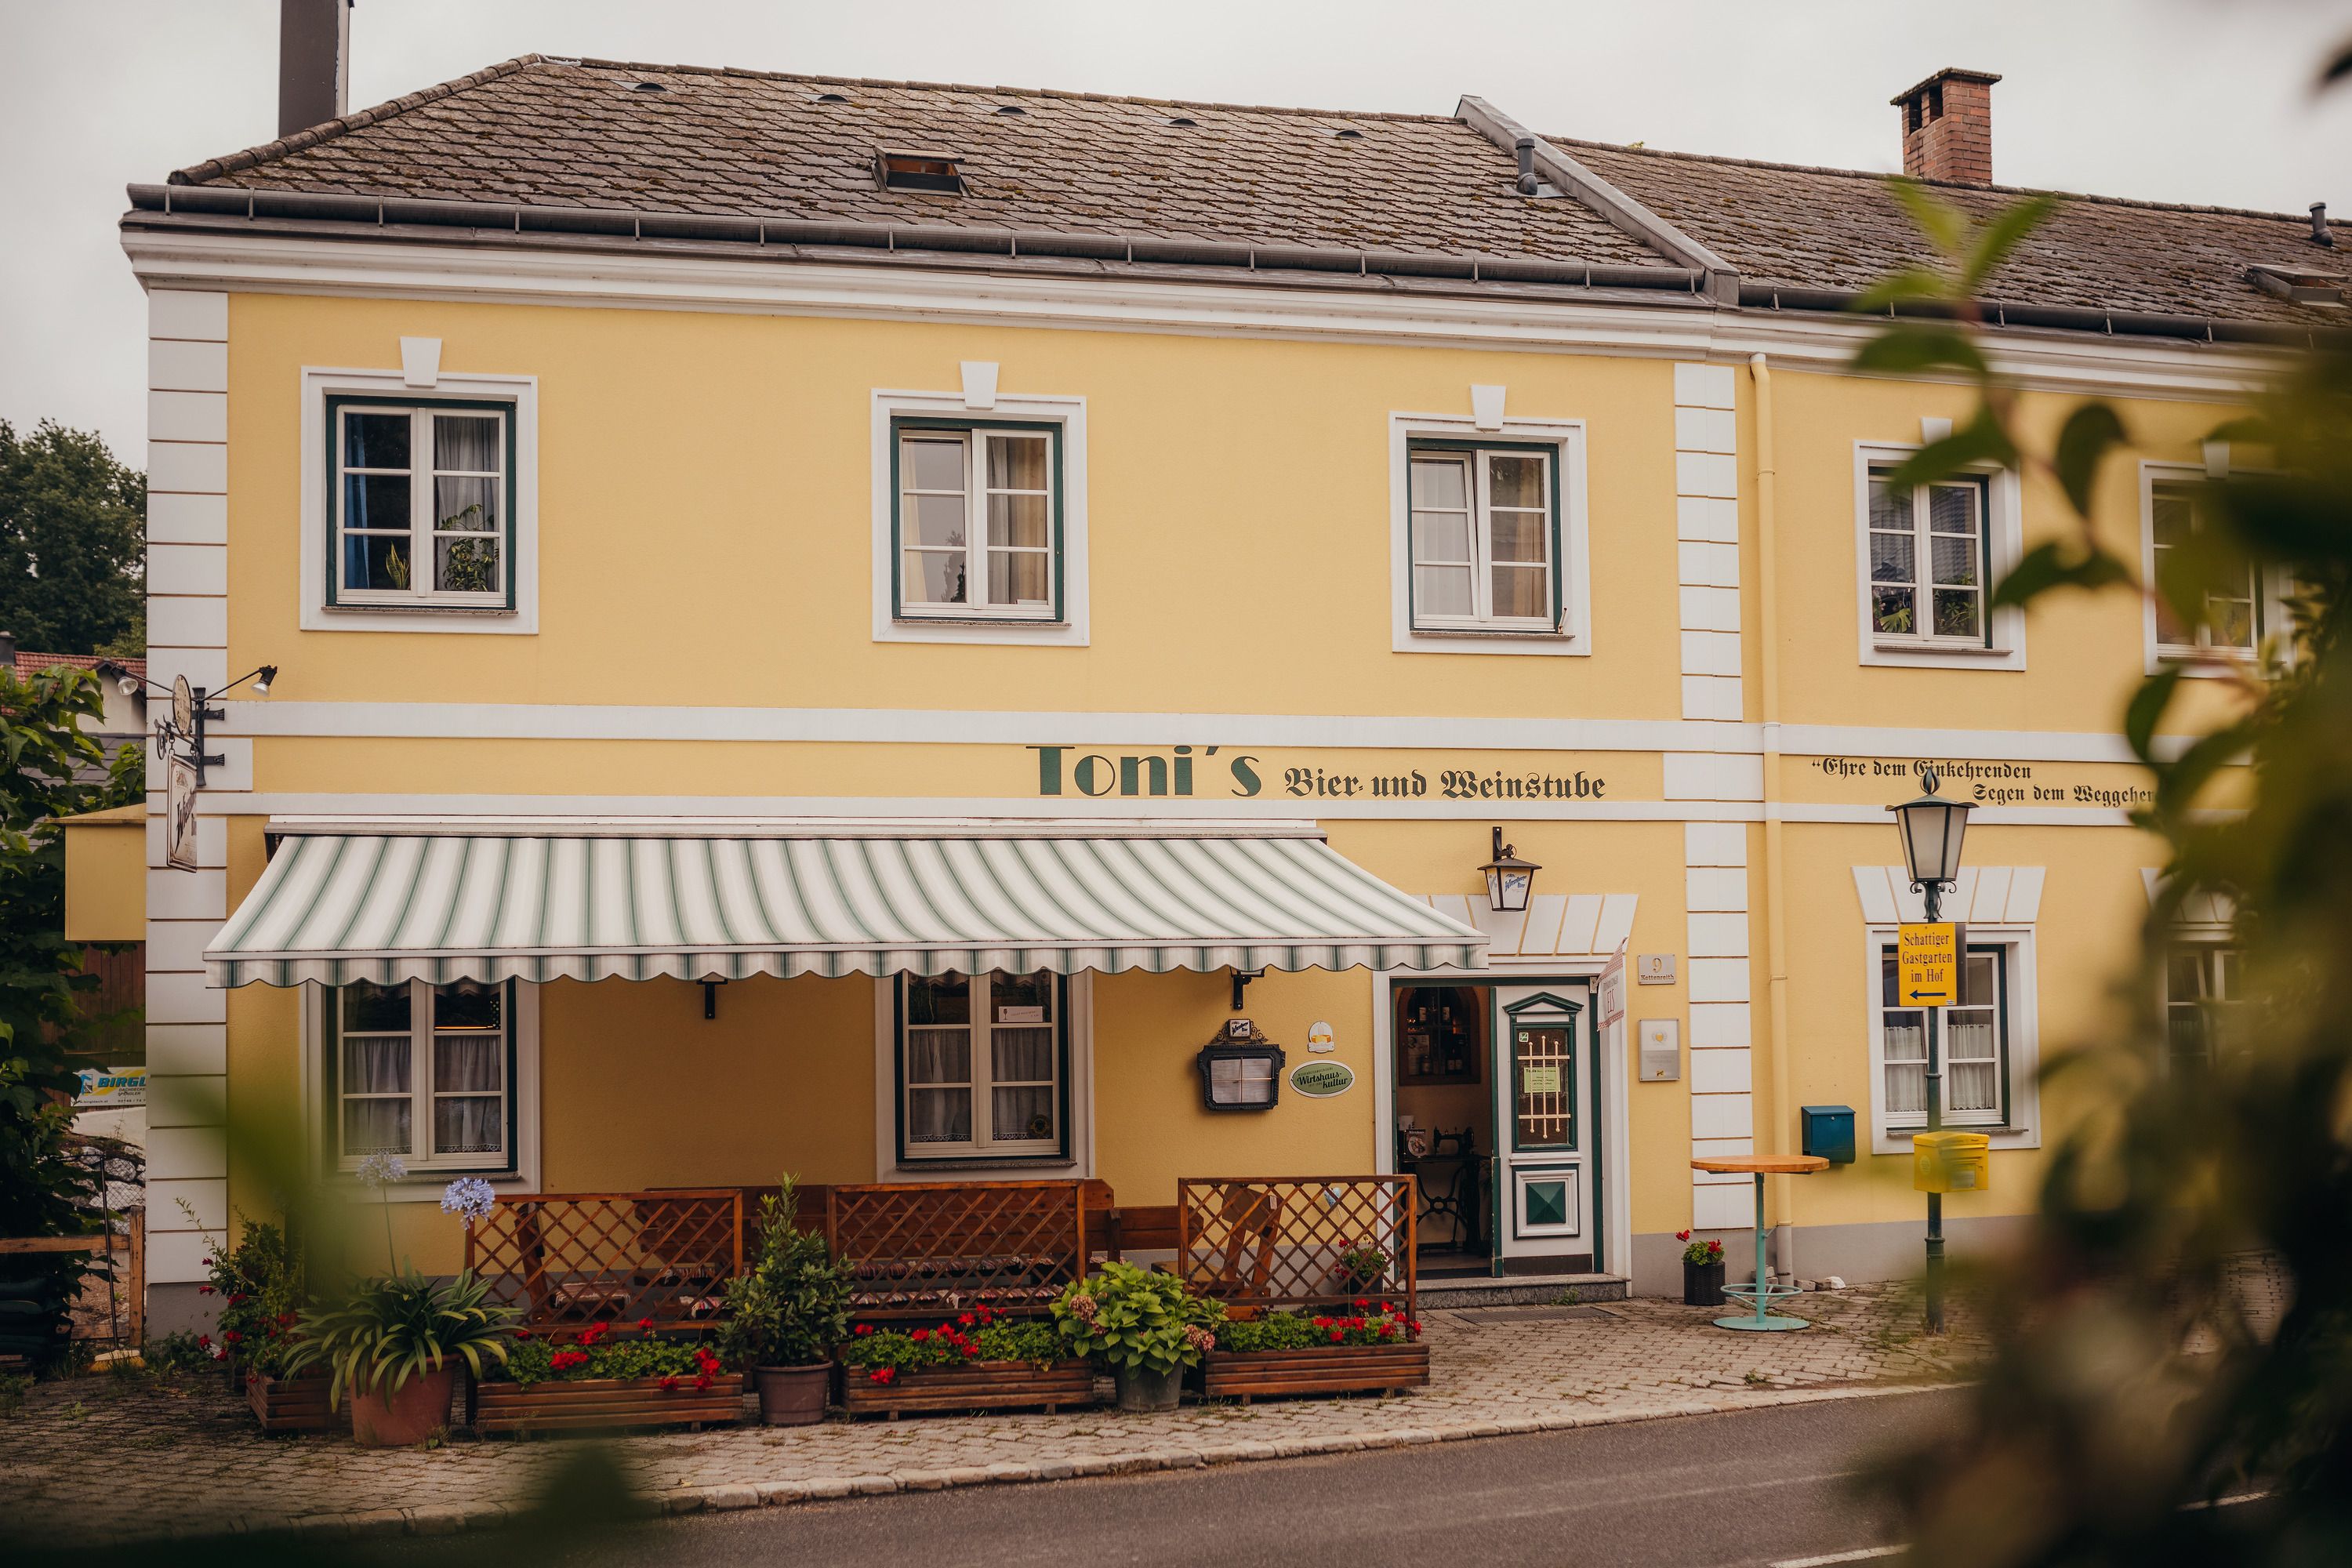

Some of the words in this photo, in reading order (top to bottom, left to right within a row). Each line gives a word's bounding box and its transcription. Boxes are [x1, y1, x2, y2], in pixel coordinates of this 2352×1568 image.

[1873, 760, 1907, 777] dem
[1284, 768, 1364, 798] Bier-
[1370, 769, 1428, 798] und
[1440, 770, 1606, 800] Weinstube
[1972, 783, 2025, 806] Segen
[2033, 784, 2065, 801] dem
[1904, 931, 1950, 947] Schattiger
[1652, 957, 1662, 973] 9
[1902, 951, 1953, 966] Gastgarten
[1911, 969, 1922, 982] im
[1926, 968, 1944, 982] Hof
[1297, 1072, 1342, 1085] Wirtshaus-
[1323, 1077, 1348, 1089] kultur
